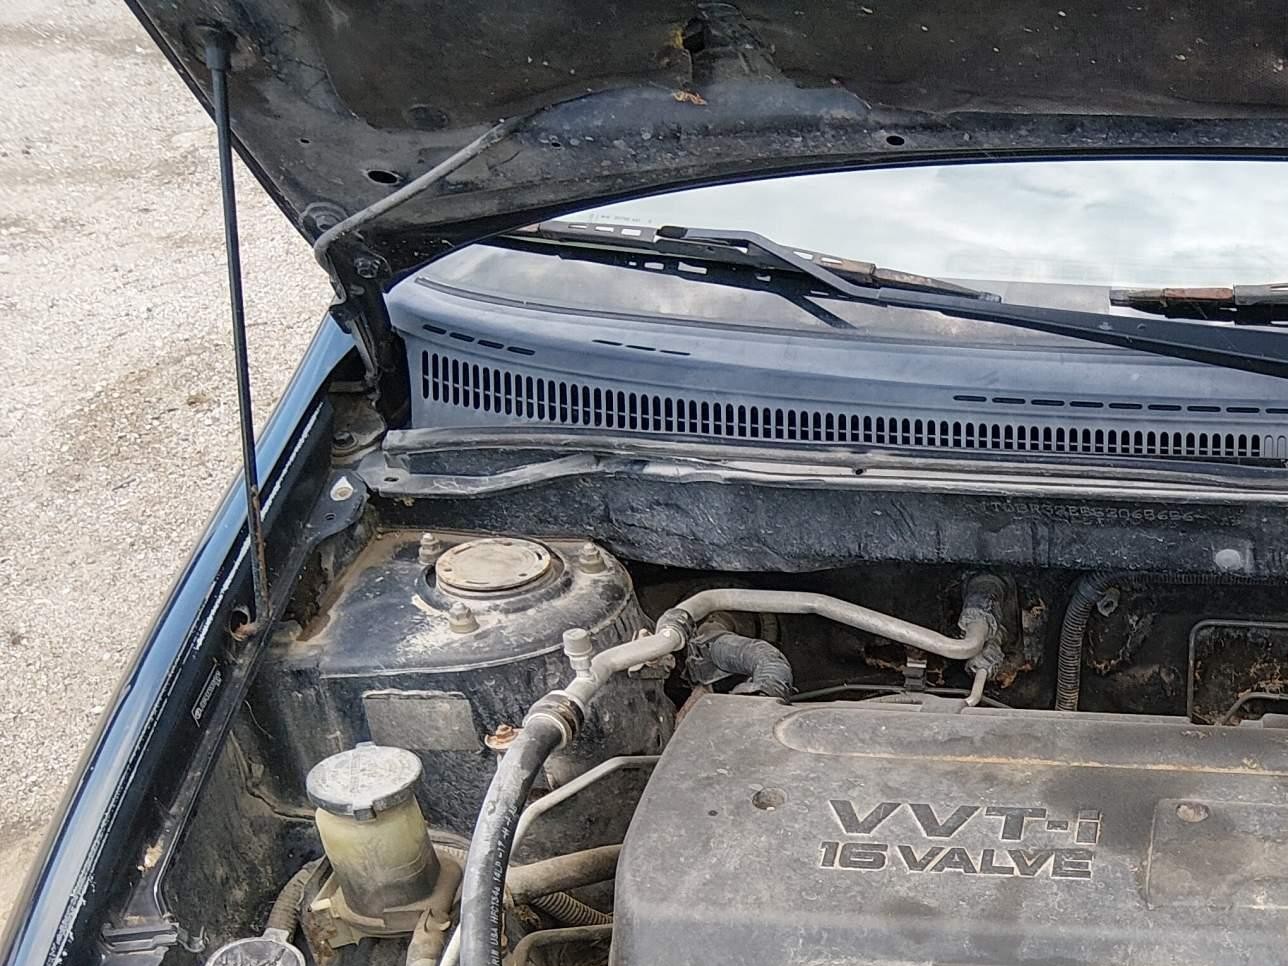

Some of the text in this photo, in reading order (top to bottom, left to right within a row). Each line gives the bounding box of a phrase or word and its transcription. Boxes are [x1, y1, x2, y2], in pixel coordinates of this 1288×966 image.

[828, 799, 1101, 845] VVT-i
[819, 841, 1095, 879] 16 VALVE
